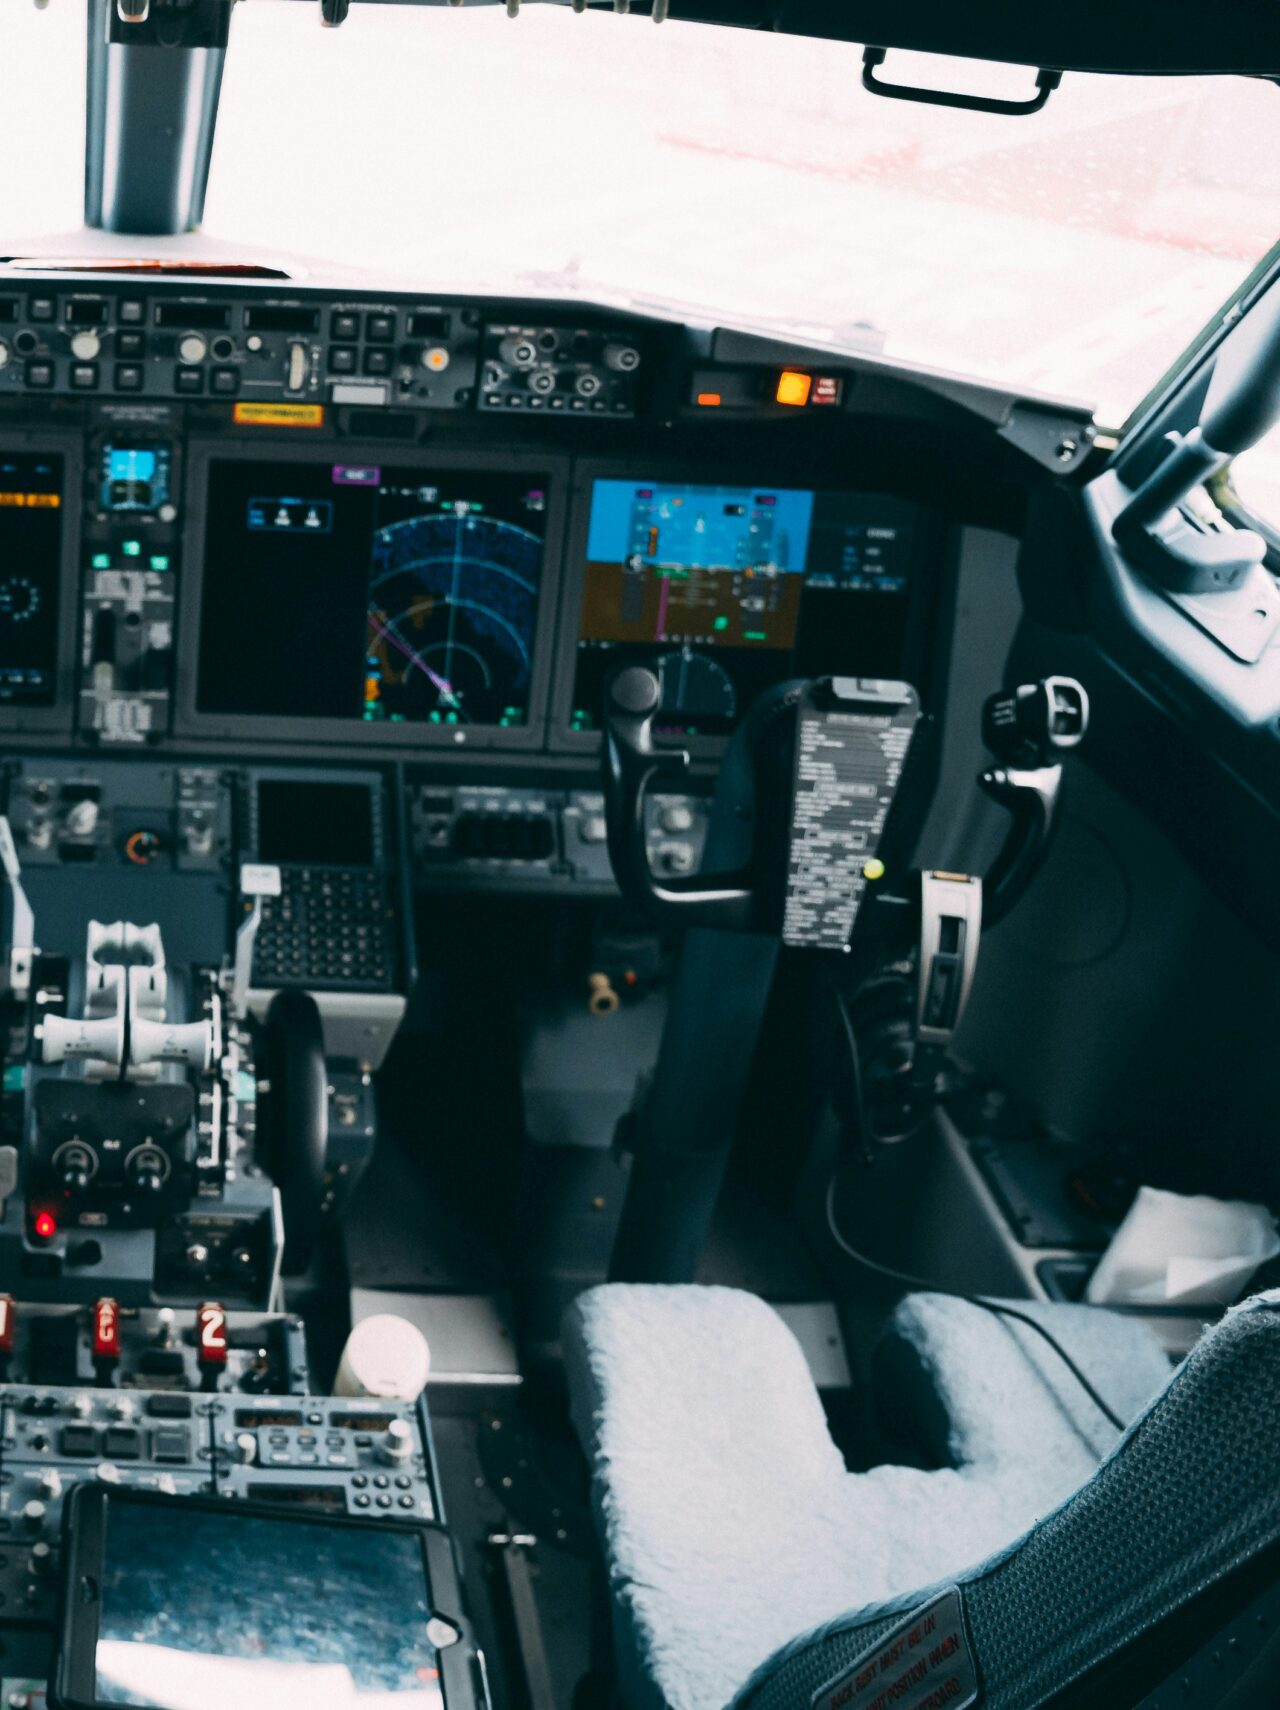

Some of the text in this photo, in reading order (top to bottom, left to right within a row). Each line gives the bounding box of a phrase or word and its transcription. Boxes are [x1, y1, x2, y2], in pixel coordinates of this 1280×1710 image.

[201, 1310, 226, 1348] 2
[879, 1638, 905, 1673] MUST
[909, 1626, 921, 1648] BE
[924, 1613, 937, 1635] IN
[886, 1656, 929, 1704] POSITION
[928, 1632, 961, 1669] WHEN
